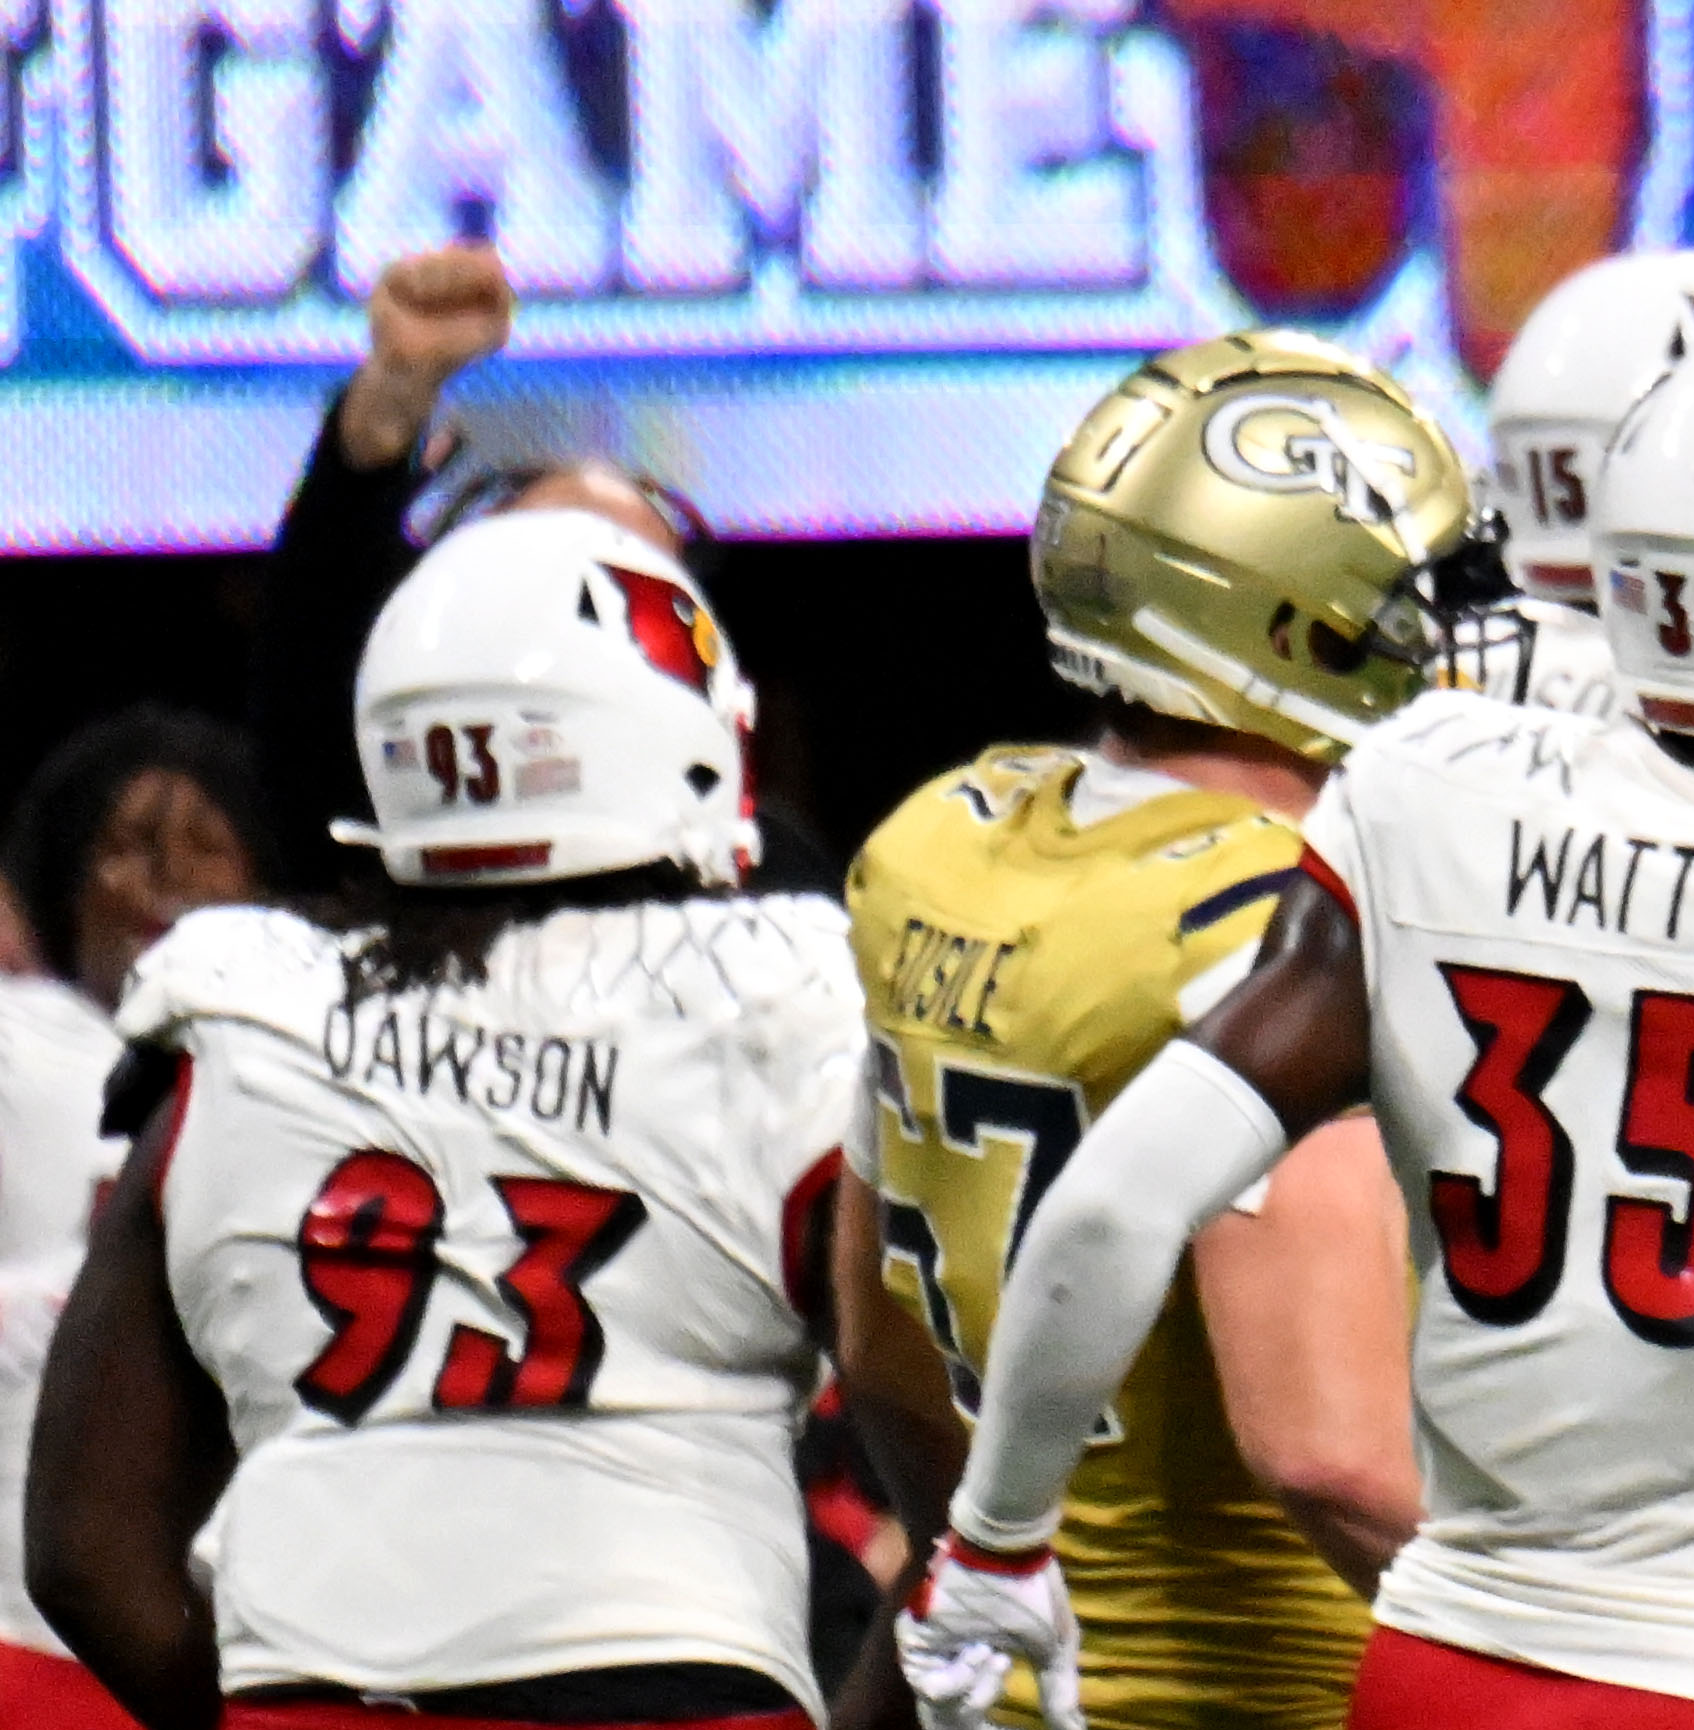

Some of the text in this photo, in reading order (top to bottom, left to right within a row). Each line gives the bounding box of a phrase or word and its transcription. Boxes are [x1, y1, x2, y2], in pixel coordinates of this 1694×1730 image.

[1528, 448, 1586, 526] 15
[424, 722, 499, 808] 93
[322, 1000, 620, 1138] DAWSON
[292, 1146, 648, 1427] 93
